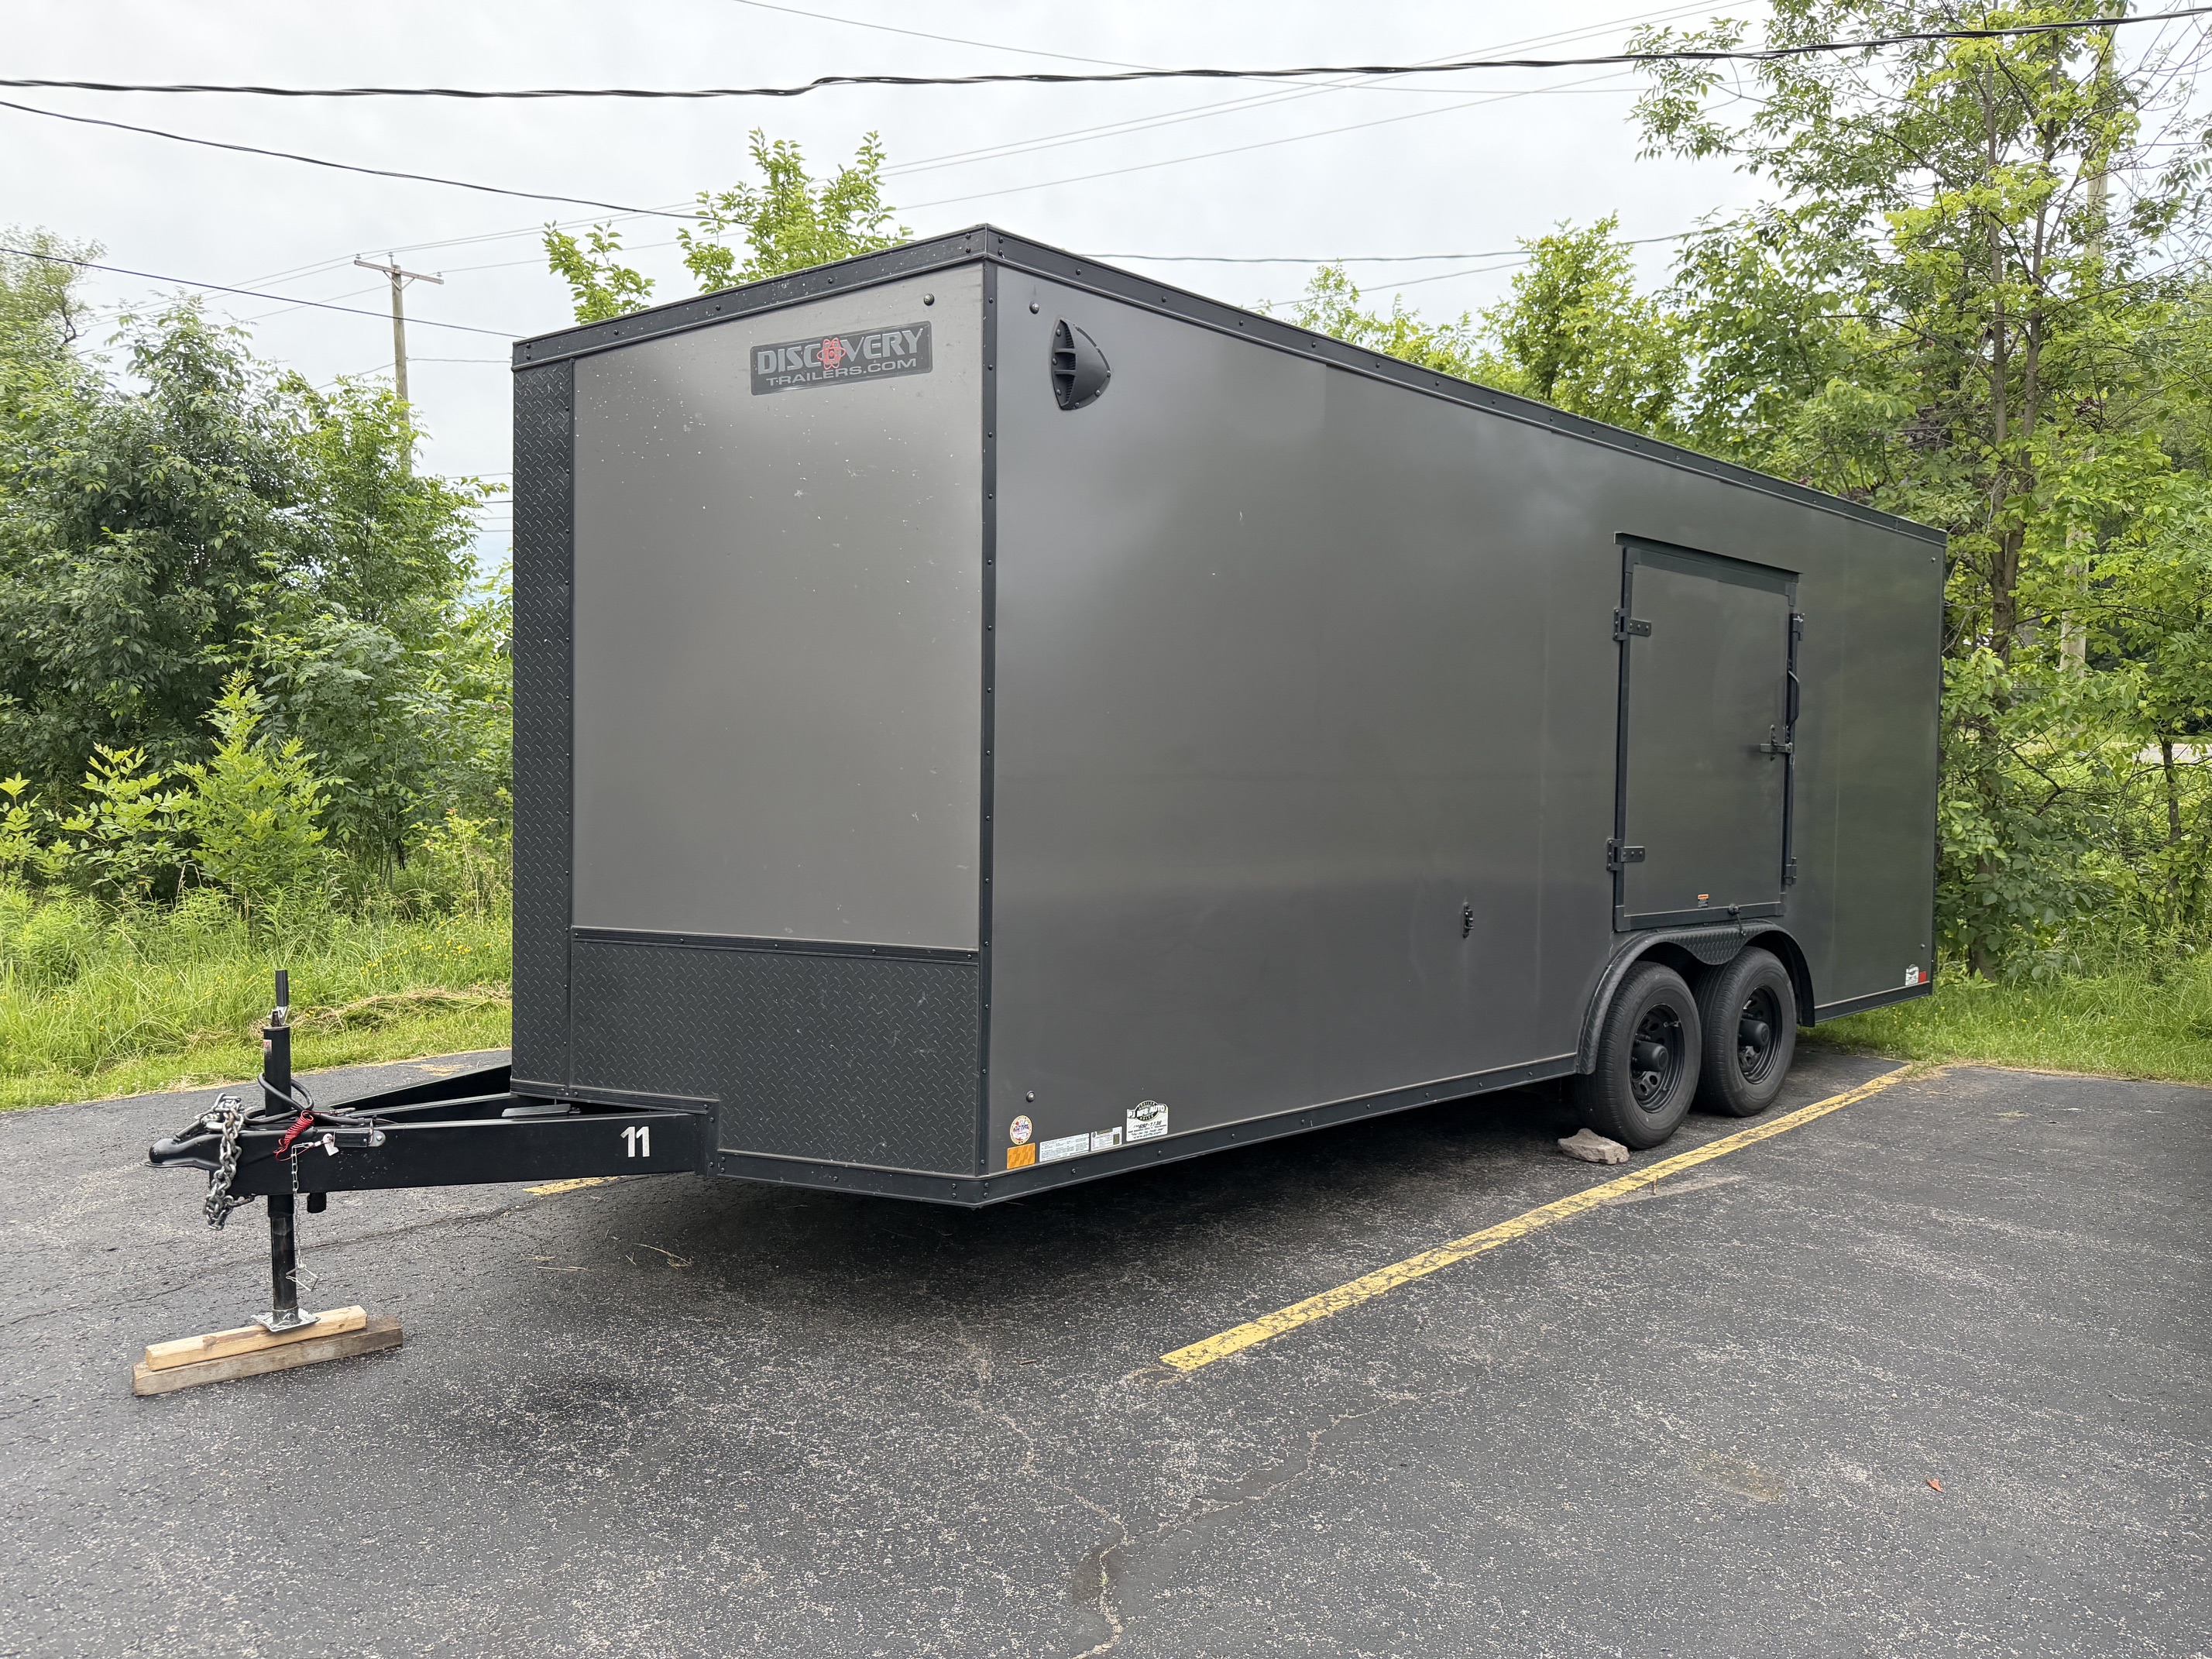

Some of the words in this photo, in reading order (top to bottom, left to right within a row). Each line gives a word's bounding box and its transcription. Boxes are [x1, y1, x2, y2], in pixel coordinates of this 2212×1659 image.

[757, 328, 924, 375] DISCOVERY
[765, 358, 917, 386] TRAILERS.COM
[1149, 1104, 1166, 1114] AUTO
[620, 1125, 650, 1158] 11
